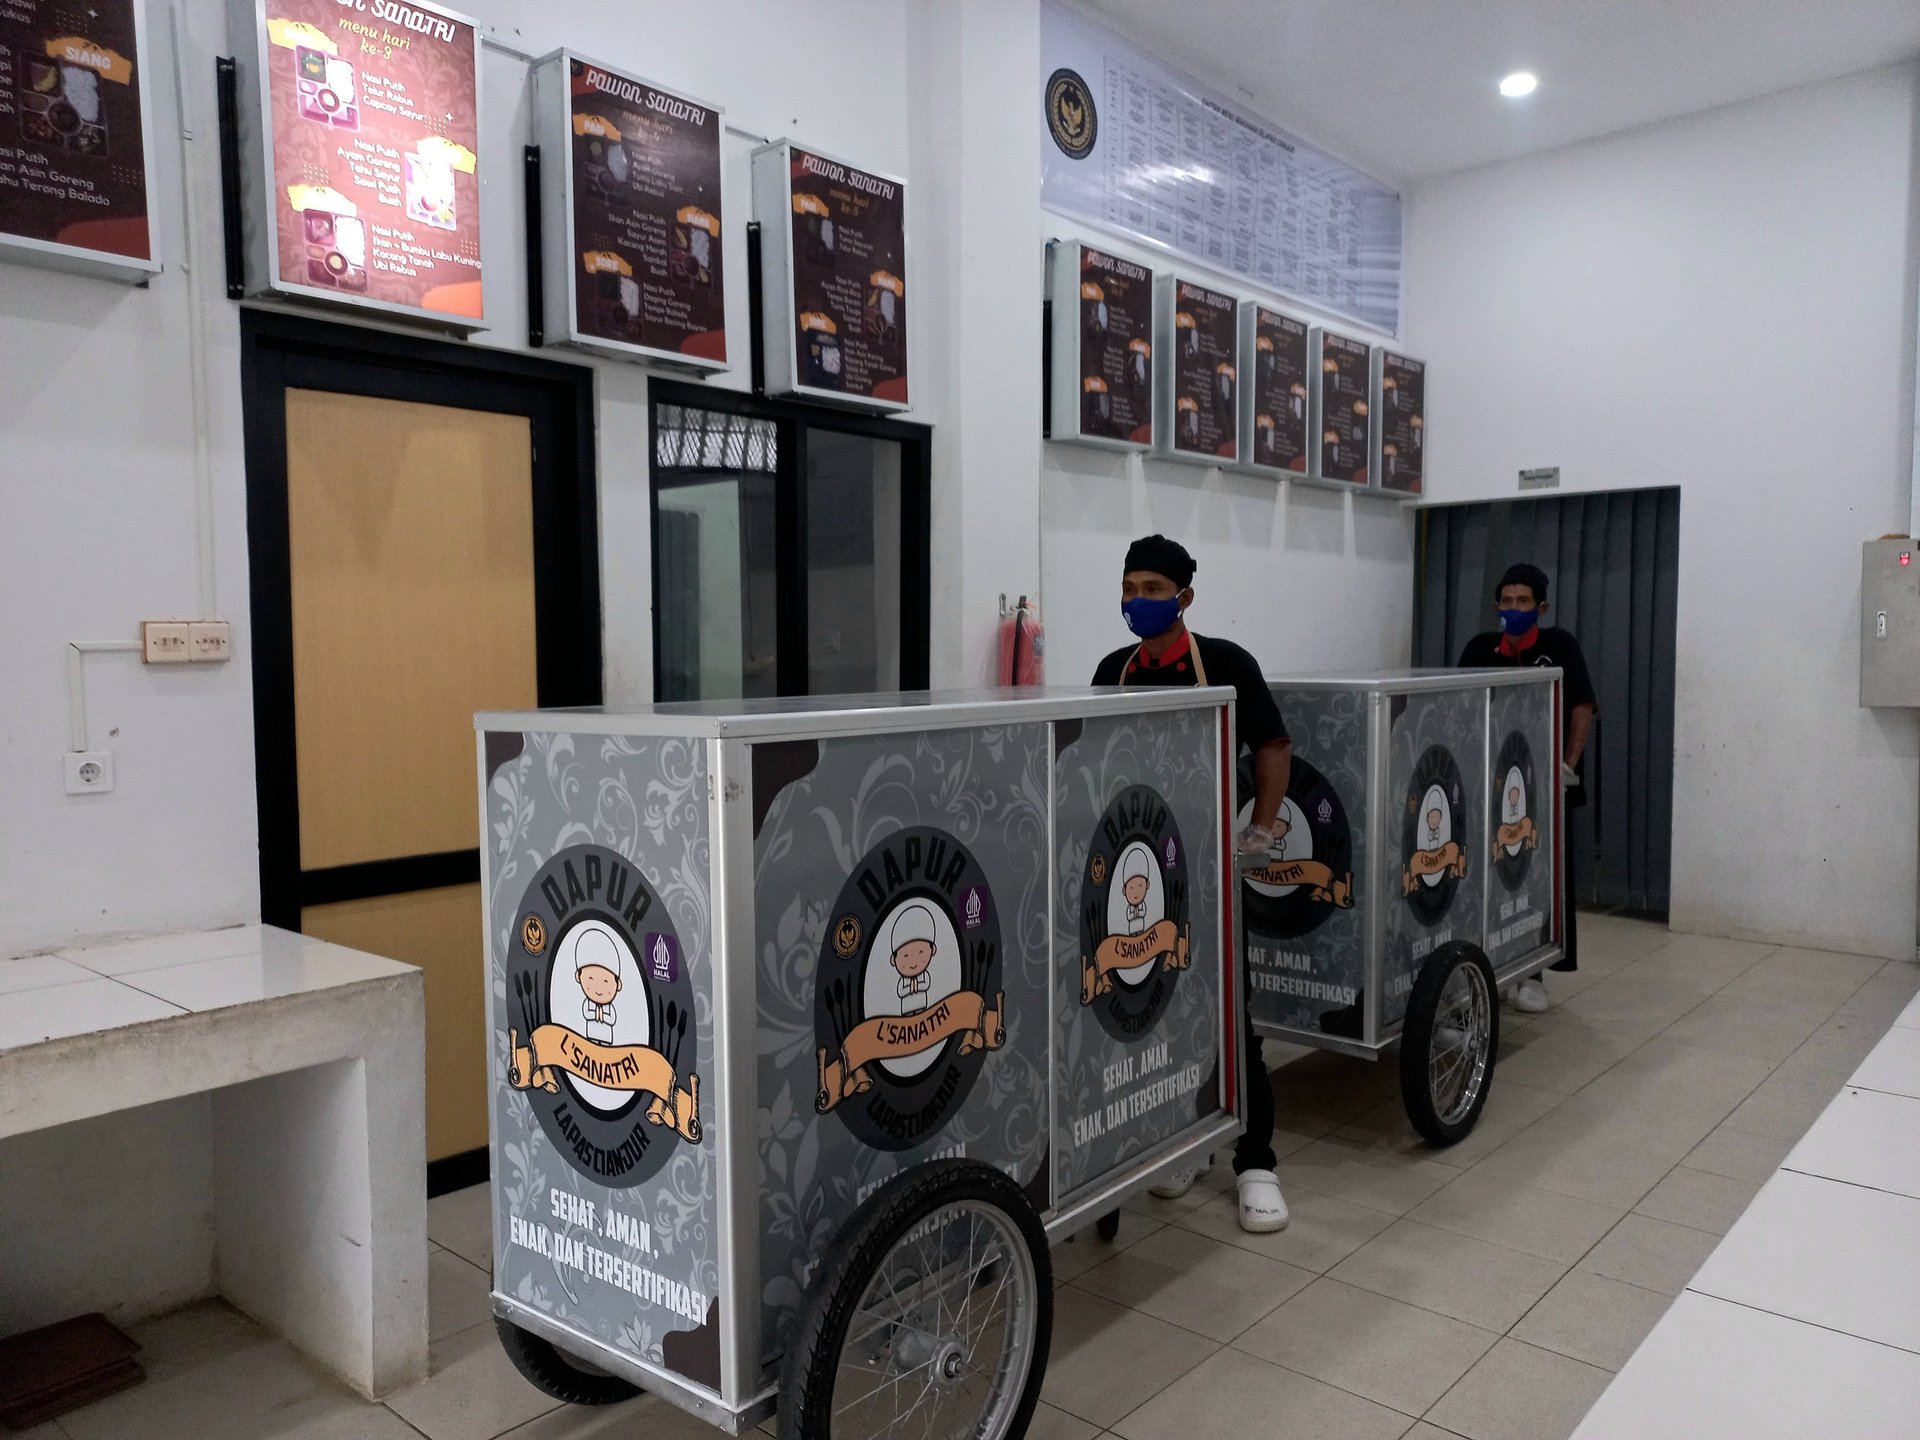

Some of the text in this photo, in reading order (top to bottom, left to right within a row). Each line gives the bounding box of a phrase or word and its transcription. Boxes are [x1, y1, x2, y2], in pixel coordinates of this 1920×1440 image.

[338, 16, 379, 40] menu
[382, 28, 411, 50] hari
[360, 38, 393, 60] ke-3
[66, 46, 112, 70] SIANG
[383, 76, 406, 93] Putih
[0, 147, 49, 165] asi Putih
[0, 174, 19, 188] ahu
[20, 164, 47, 179] Asin
[49, 170, 94, 191] Goreng
[393, 229, 416, 243] Putih
[453, 255, 482, 270] Kuning
[1103, 792, 1168, 850] DAPUR
[856, 835, 967, 914] DAPUR
[540, 854, 652, 933] DAPUR
[1114, 927, 1159, 960] L'SANATRI
[1259, 972, 1356, 1006] TERSERTIFIKASI
[876, 1001, 951, 1045] L'SANATRI
[560, 1033, 640, 1087] L'SANATRI
[1107, 1101, 1128, 1130] DAN
[1129, 1063, 1200, 1119] TERSERTIFIKASI
[509, 1215, 708, 1327] ENAK, DAN TERSERTIFIKASI
